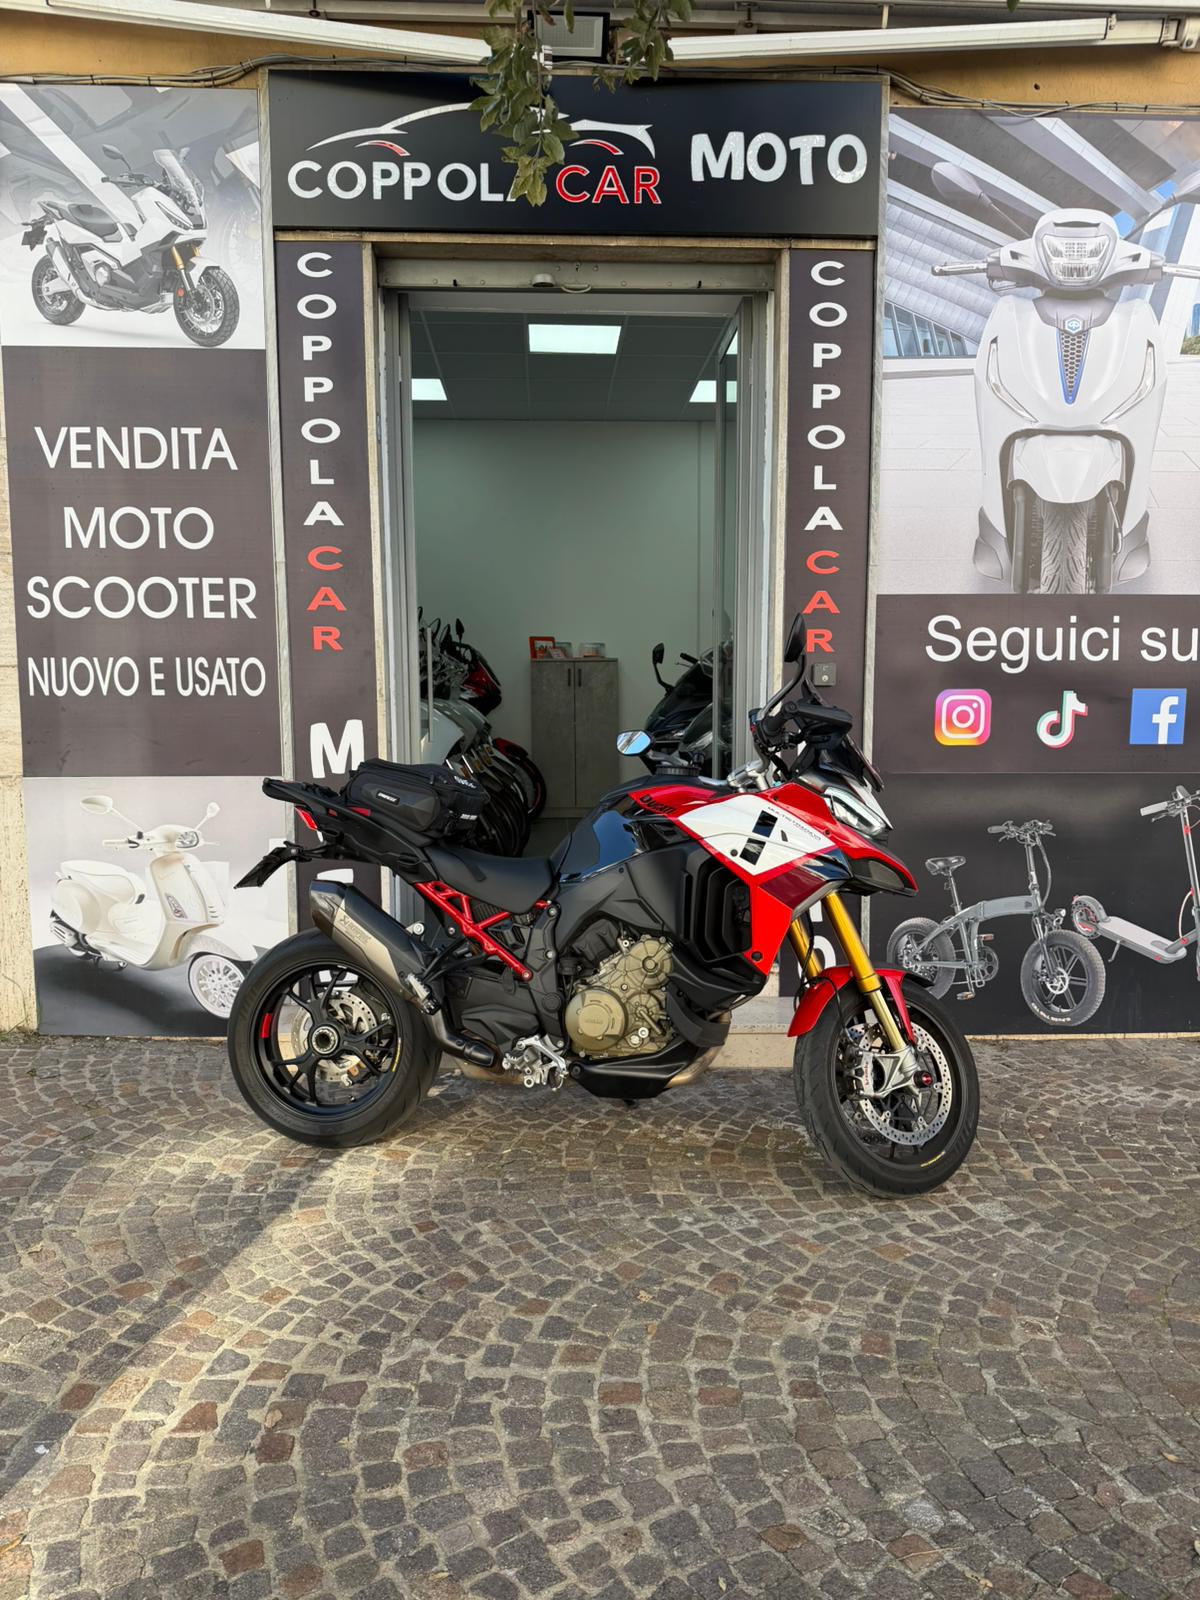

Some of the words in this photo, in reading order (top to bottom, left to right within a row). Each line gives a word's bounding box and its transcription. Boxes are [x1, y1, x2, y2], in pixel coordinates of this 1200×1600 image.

[287, 160, 526, 202] COPPOL
[556, 164, 662, 205] CAR
[690, 131, 868, 185] MOTO
[33, 426, 239, 471] VENDITA
[63, 505, 215, 550] MOTO
[26, 575, 257, 620] SCOOTER
[925, 614, 1121, 674] Seguici
[1140, 626, 1199, 662] su
[27, 655, 140, 698] NUOVO
[149, 656, 166, 696] E
[175, 656, 266, 698] USATO
